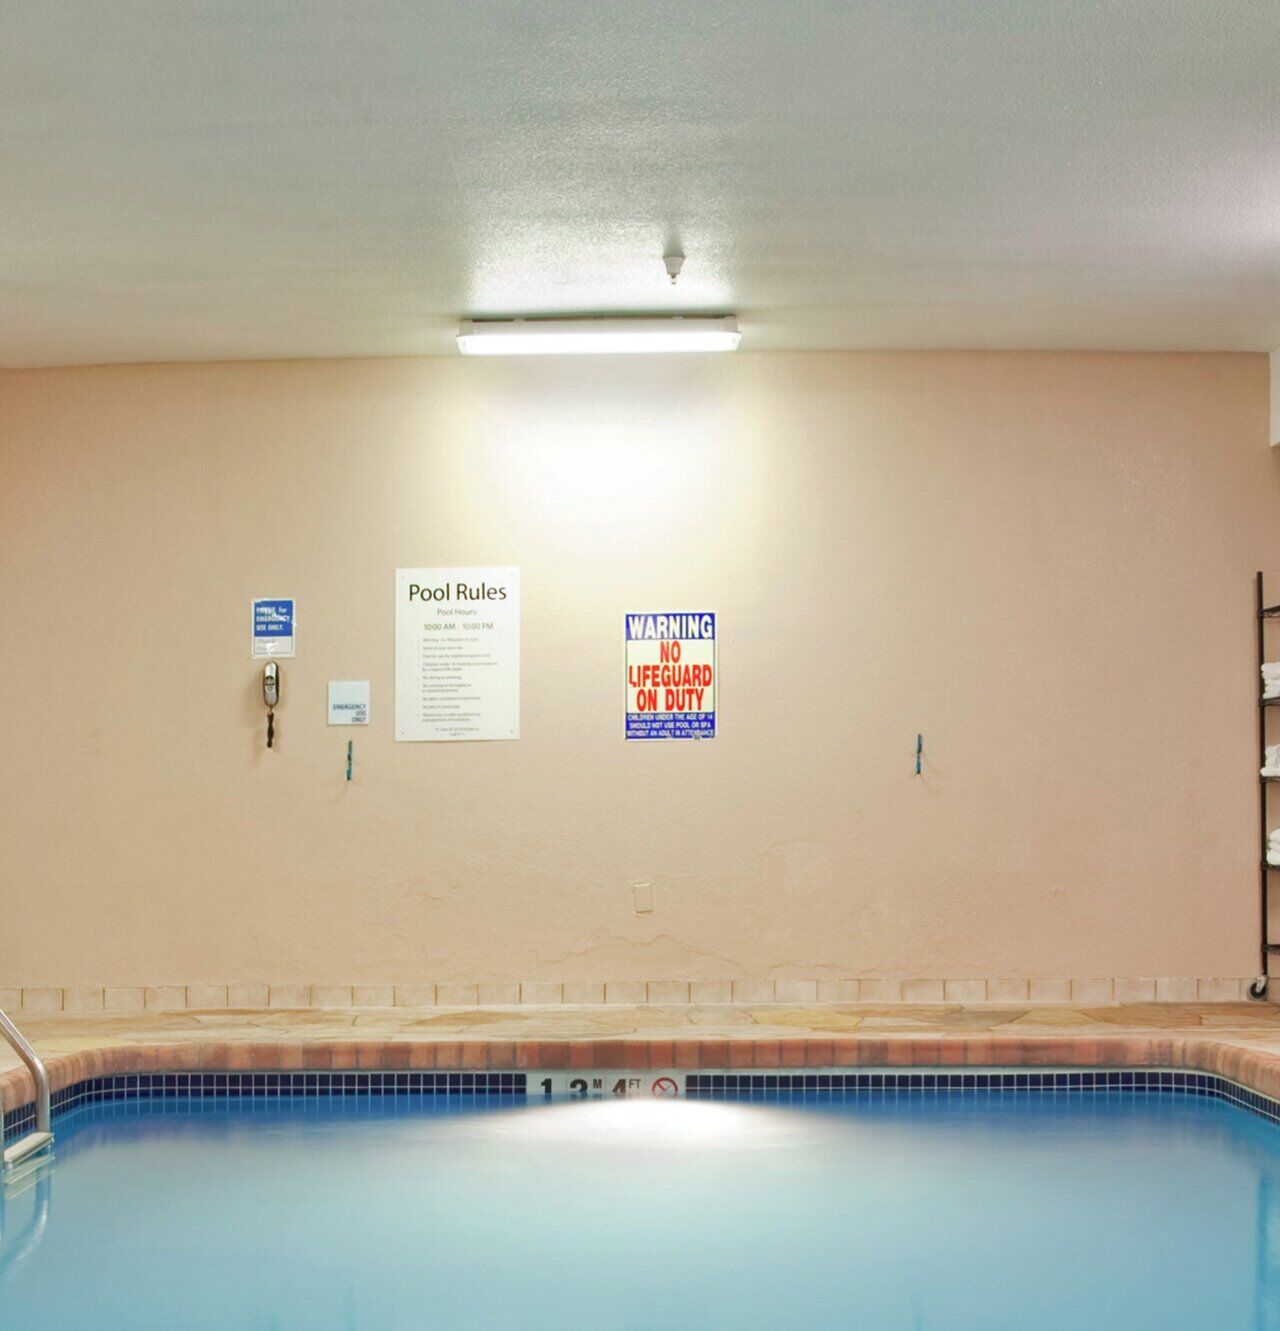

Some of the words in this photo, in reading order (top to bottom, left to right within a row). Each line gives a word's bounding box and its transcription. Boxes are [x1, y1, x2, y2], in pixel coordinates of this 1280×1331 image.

[409, 582, 450, 601] Pool
[456, 582, 506, 601] Rules
[437, 608, 453, 616] Pool
[628, 615, 713, 639] WARNING
[660, 640, 681, 663] NO
[628, 664, 712, 687] LIFEGUARD
[637, 689, 657, 711] ON
[665, 688, 704, 711] DUTY
[627, 713, 654, 721] CHILDREN
[675, 721, 690, 729] POOL
